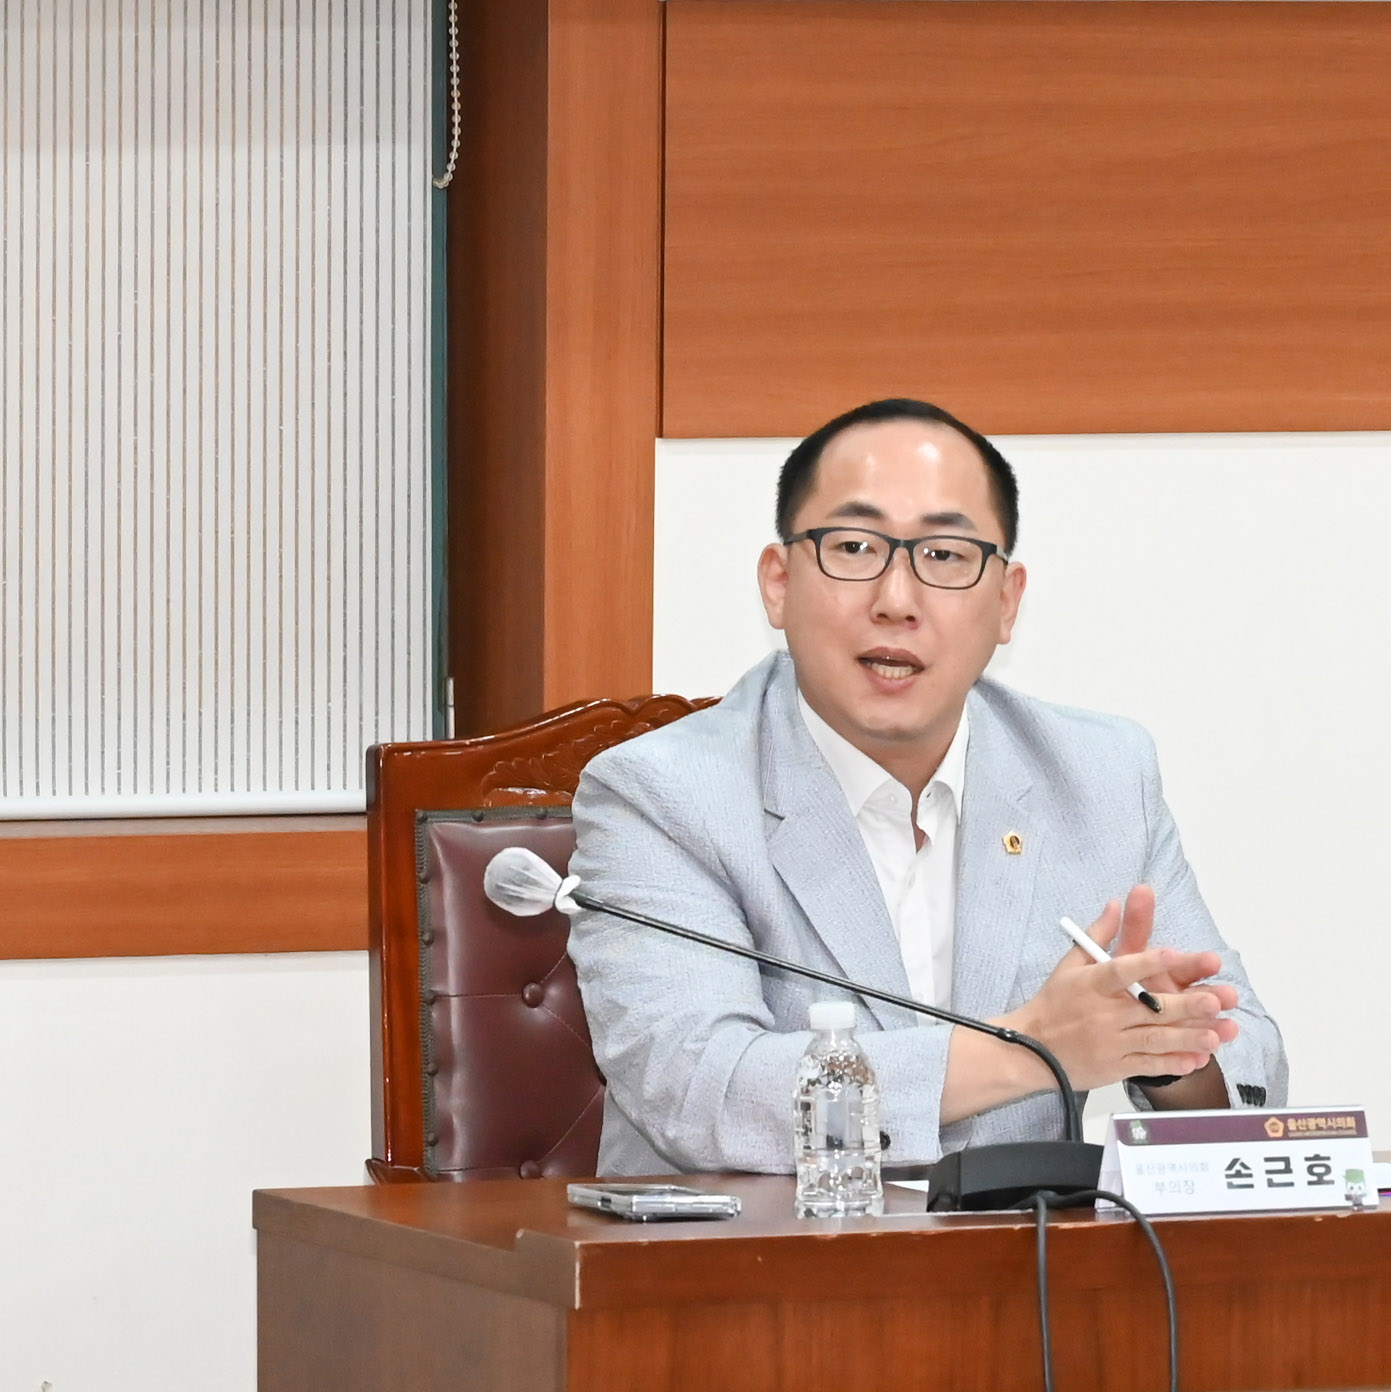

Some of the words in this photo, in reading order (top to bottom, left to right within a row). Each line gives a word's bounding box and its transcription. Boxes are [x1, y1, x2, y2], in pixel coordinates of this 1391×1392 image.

[1287, 1116, 1356, 1131] 울산광역시의회
[1225, 1154, 1335, 1189] 손근호
[1155, 1179, 1195, 1195] 부의장
